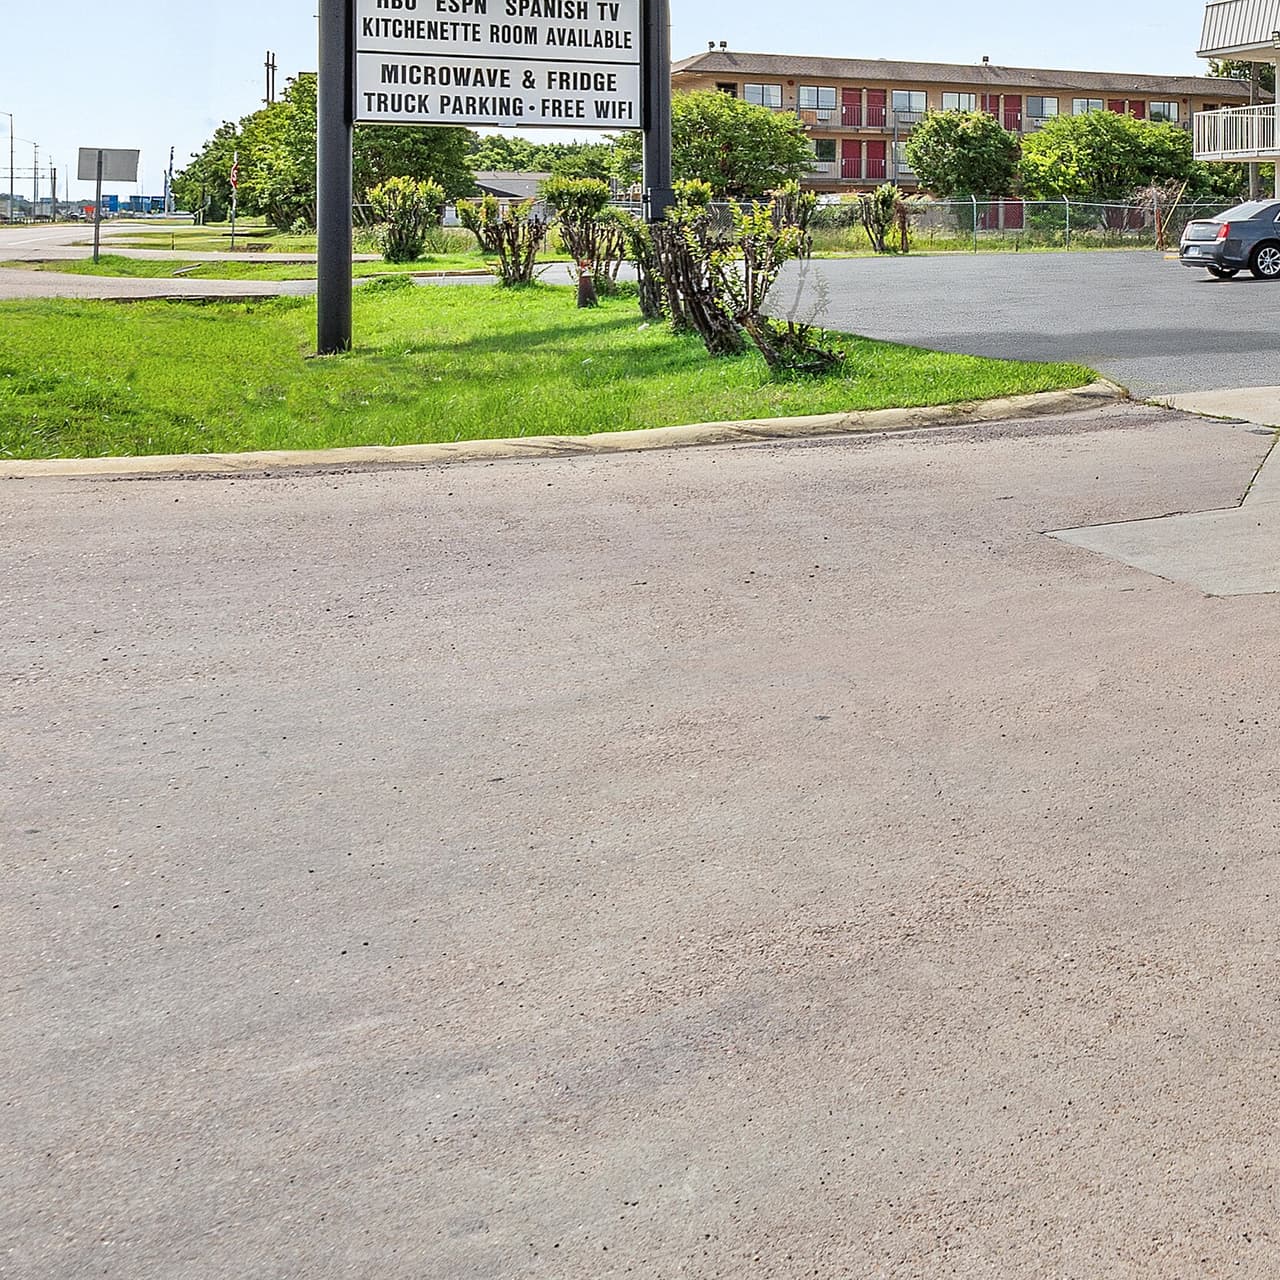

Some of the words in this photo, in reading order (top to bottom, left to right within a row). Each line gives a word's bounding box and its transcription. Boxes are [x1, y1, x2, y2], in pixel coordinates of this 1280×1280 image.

[597, 2, 620, 22] TV
[362, 17, 482, 43] KITCHENETTE
[489, 24, 538, 46] ROOM
[546, 27, 633, 50] AVAILABLE
[381, 63, 511, 89] MICROWAVE
[521, 69, 537, 90] &
[547, 70, 617, 92] FRIDGE
[363, 92, 430, 114] TRUCK
[439, 95, 524, 117] PARKING
[541, 99, 586, 119] FREE
[594, 100, 633, 120] WIFI
